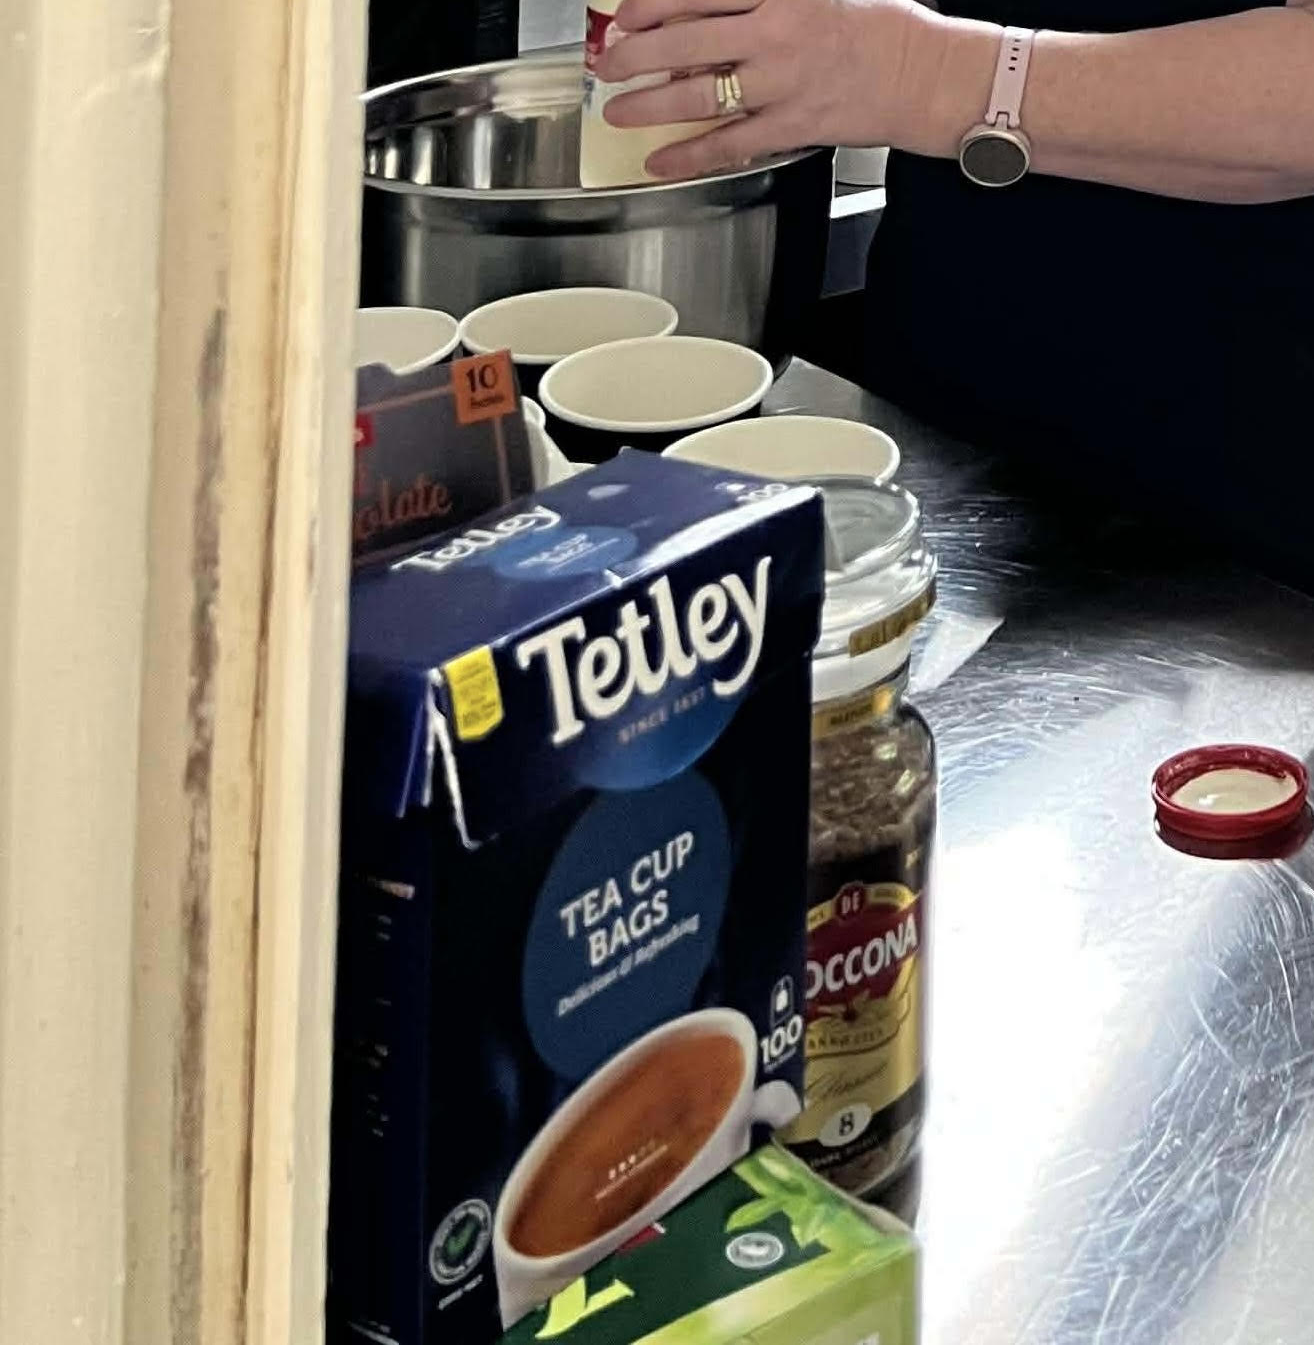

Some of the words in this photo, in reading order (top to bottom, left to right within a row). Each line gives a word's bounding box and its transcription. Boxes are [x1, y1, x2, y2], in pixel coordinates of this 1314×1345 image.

[466, 364, 499, 393] 10
[390, 505, 562, 571] Tetley
[516, 556, 773, 747] Tetley
[560, 877, 624, 939] TEA
[630, 830, 695, 895] CUP
[840, 890, 862, 915] DE
[589, 888, 669, 968] BAGS
[760, 1013, 804, 1065] 100
[839, 1111, 855, 1137] 8
